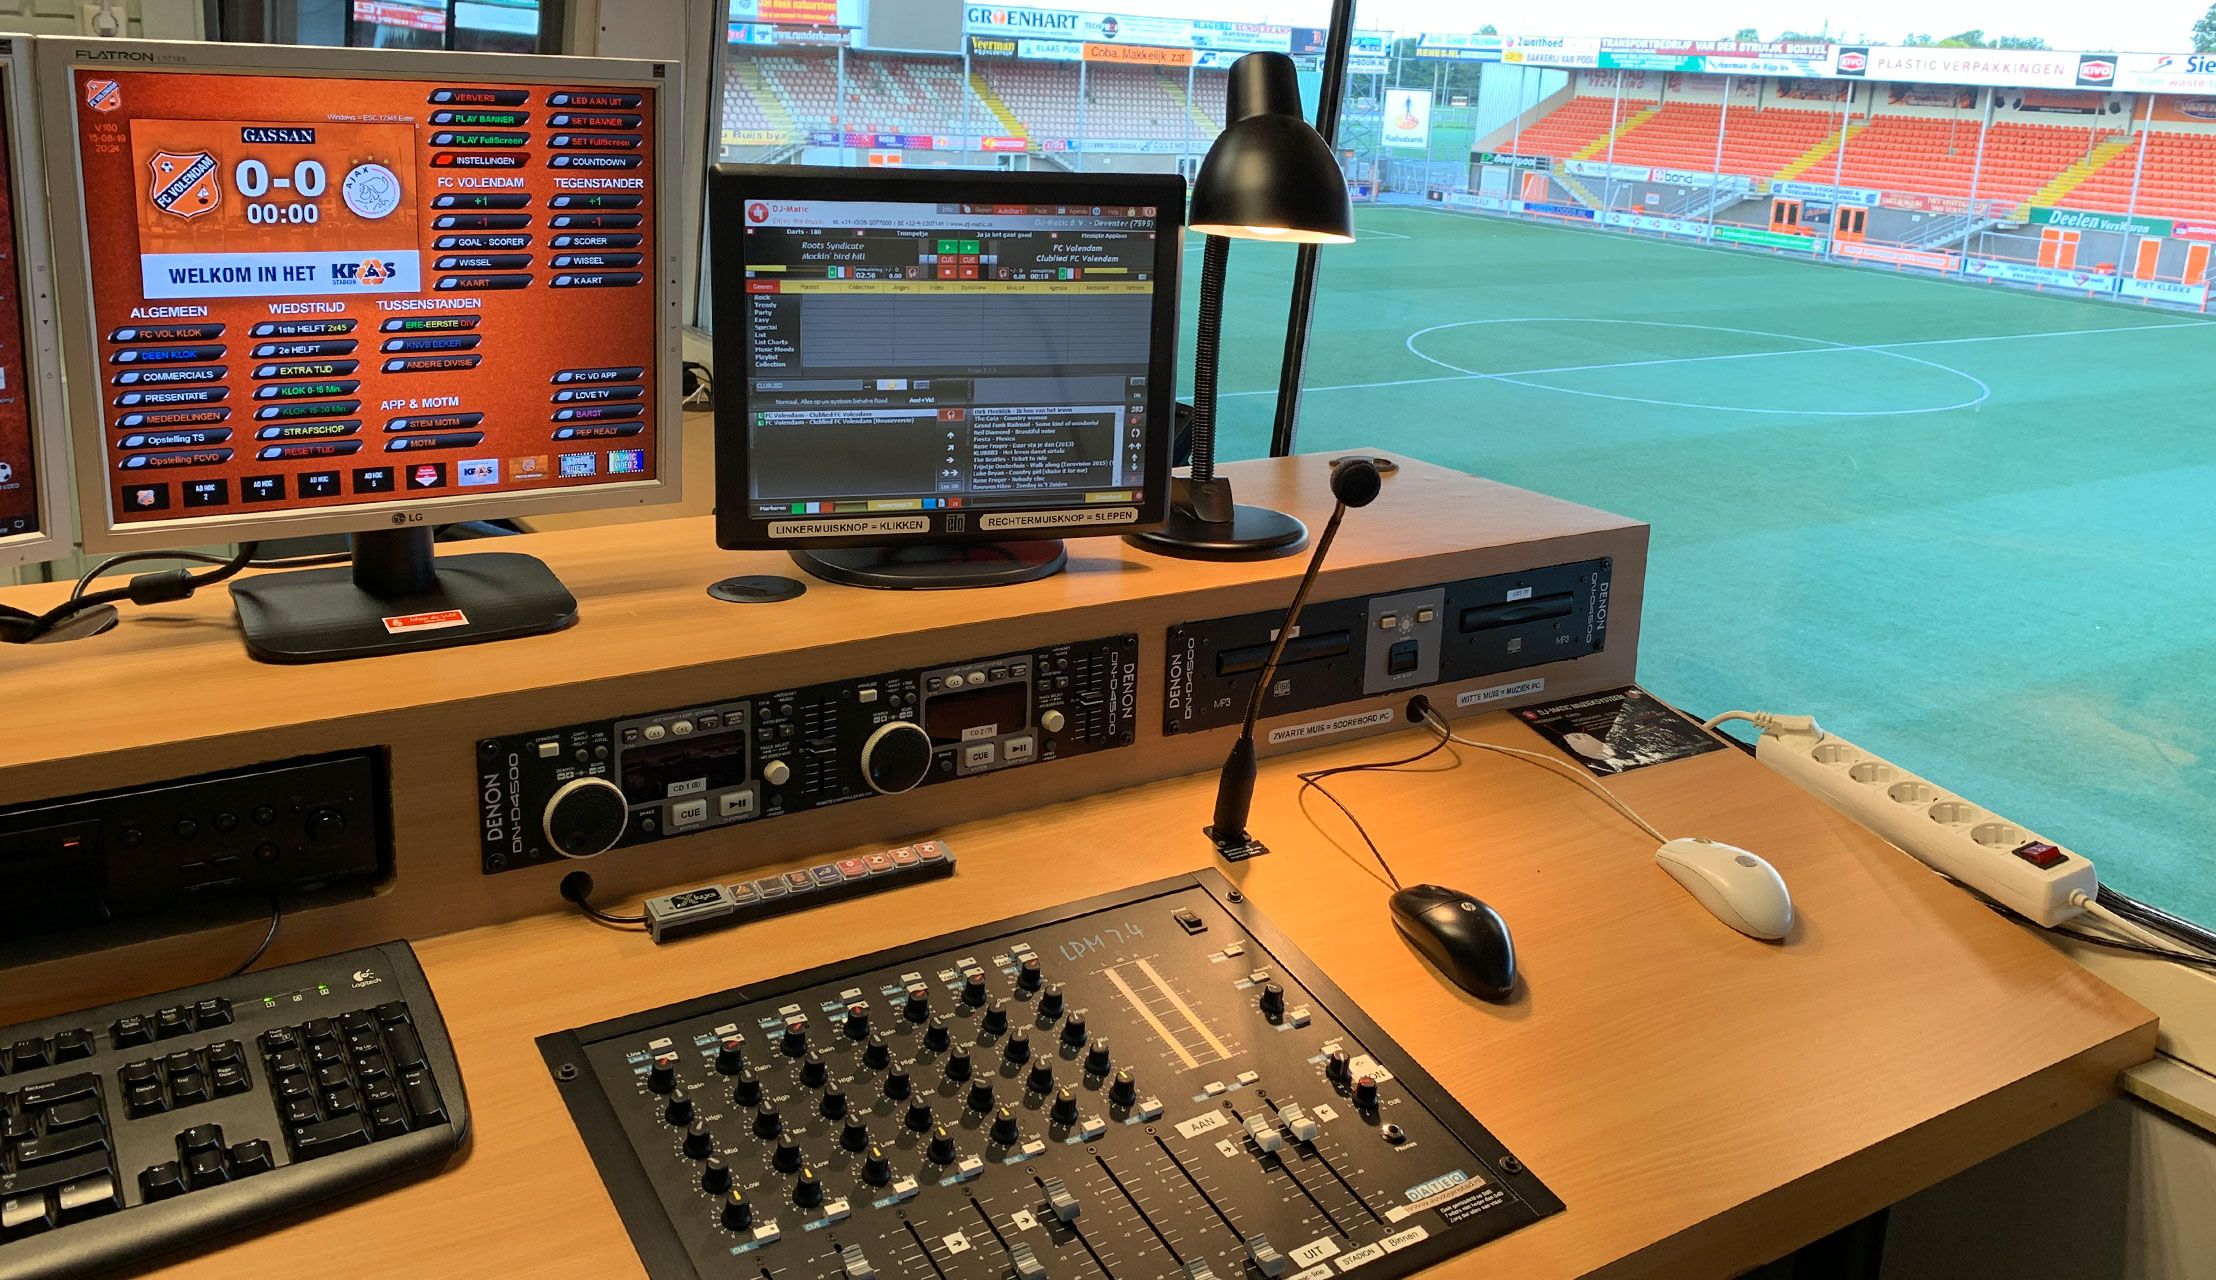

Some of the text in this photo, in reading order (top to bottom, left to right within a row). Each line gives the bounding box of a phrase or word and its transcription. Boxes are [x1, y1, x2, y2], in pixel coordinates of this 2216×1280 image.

[972, 37, 1015, 51] Veerman
[1518, 38, 1563, 47] Zwarthoed
[1695, 41, 1714, 50] VAN
[75, 51, 153, 62] FLATRON
[1171, 52, 1185, 62] zat
[1562, 55, 1574, 63] VAN
[1878, 59, 2065, 75] PLASTIC VERPAKKINGEN
[454, 94, 495, 102] VERVERS
[243, 129, 313, 142] GASSAN
[456, 136, 478, 144] PLAY
[1385, 135, 1424, 143] Rabobank
[573, 158, 626, 166] COUNTDOWN
[156, 157, 214, 209] FC VOLENDAM
[345, 167, 369, 189] AJAX
[438, 178, 524, 188] FC VOLENDAM
[554, 178, 643, 188] TEGENSTANDER
[247, 204, 318, 223] 00:00
[2049, 210, 2098, 228] Deelen
[573, 237, 607, 245] SCORER
[827, 242, 864, 250] Syndicate
[169, 266, 315, 284] WELKOM IN HET
[574, 277, 602, 285] KAART
[269, 303, 345, 314] WEDSTRIJD
[376, 299, 481, 310] TUSSENSTANDEN
[131, 306, 208, 319] ALGEMEEN
[461, 319, 474, 327] DIV
[407, 339, 461, 349] KNVB BEKER
[278, 345, 320, 355] 2e HELFT
[280, 366, 332, 375] EXTRA TIJD
[576, 371, 617, 380] FC VD APP
[143, 371, 213, 382] COMMERCIALS
[145, 392, 208, 402] PRESENTATIE
[576, 390, 609, 399] LOVE TV
[380, 397, 459, 410] APP & MOTM
[146, 413, 220, 423] MEDEDELINGEN
[410, 418, 459, 428] STEM MOTM
[284, 425, 344, 435] STRAFSCHOP
[149, 434, 205, 446] Opstelling TS
[410, 438, 436, 447] MOTM
[284, 446, 335, 456] RESET TIJD
[150, 454, 219, 466] Opstelling FCVD
[408, 513, 423, 522] LG
[989, 515, 1083, 526] RECHTERMUISKNOP
[1095, 512, 1132, 520] SLEPEN
[776, 523, 869, 534] LINKERMUISKNOP
[880, 521, 923, 530] KLIKKEN
[1586, 572, 1598, 643] DN-D4500
[1598, 582, 1608, 630] DENON
[1556, 635, 1569, 645] MP3
[1169, 654, 1181, 708] DENON
[1184, 637, 1196, 719] DN-D4500
[1108, 651, 1118, 736] DN-D4500
[1122, 663, 1134, 719] DENON
[1461, 693, 1482, 703] WITTE
[1483, 691, 1499, 699] MUIS
[1506, 683, 1529, 694] MUZIEK
[1531, 680, 1541, 689] PC
[1214, 698, 1231, 708] MP3
[1273, 727, 1304, 740] ZWARTE
[1307, 724, 1325, 734] MUIS
[1332, 715, 1377, 731] SCOREBORD
[1378, 712, 1389, 721] PC
[973, 752, 989, 761] CUE
[484, 773, 503, 841] DENON
[509, 752, 522, 853] DN-D4500
[681, 808, 701, 819] CUE
[351, 976, 382, 990] Logitech
[754, 1064, 772, 1073] Gain
[837, 1075, 854, 1085] High
[688, 1081, 705, 1091] Gain
[705, 1113, 723, 1122] High
[1192, 1117, 1216, 1132] AAN
[880, 1139, 896, 1148] Low
[1395, 1142, 1417, 1153] Phones
[724, 1147, 738, 1155] Mid
[813, 1160, 829, 1169] Low
[1410, 1175, 1465, 1200] DATEQ
[1388, 1231, 1419, 1246] Binnen
[1303, 1246, 1323, 1259] UIT
[1343, 1248, 1375, 1265] STADION
